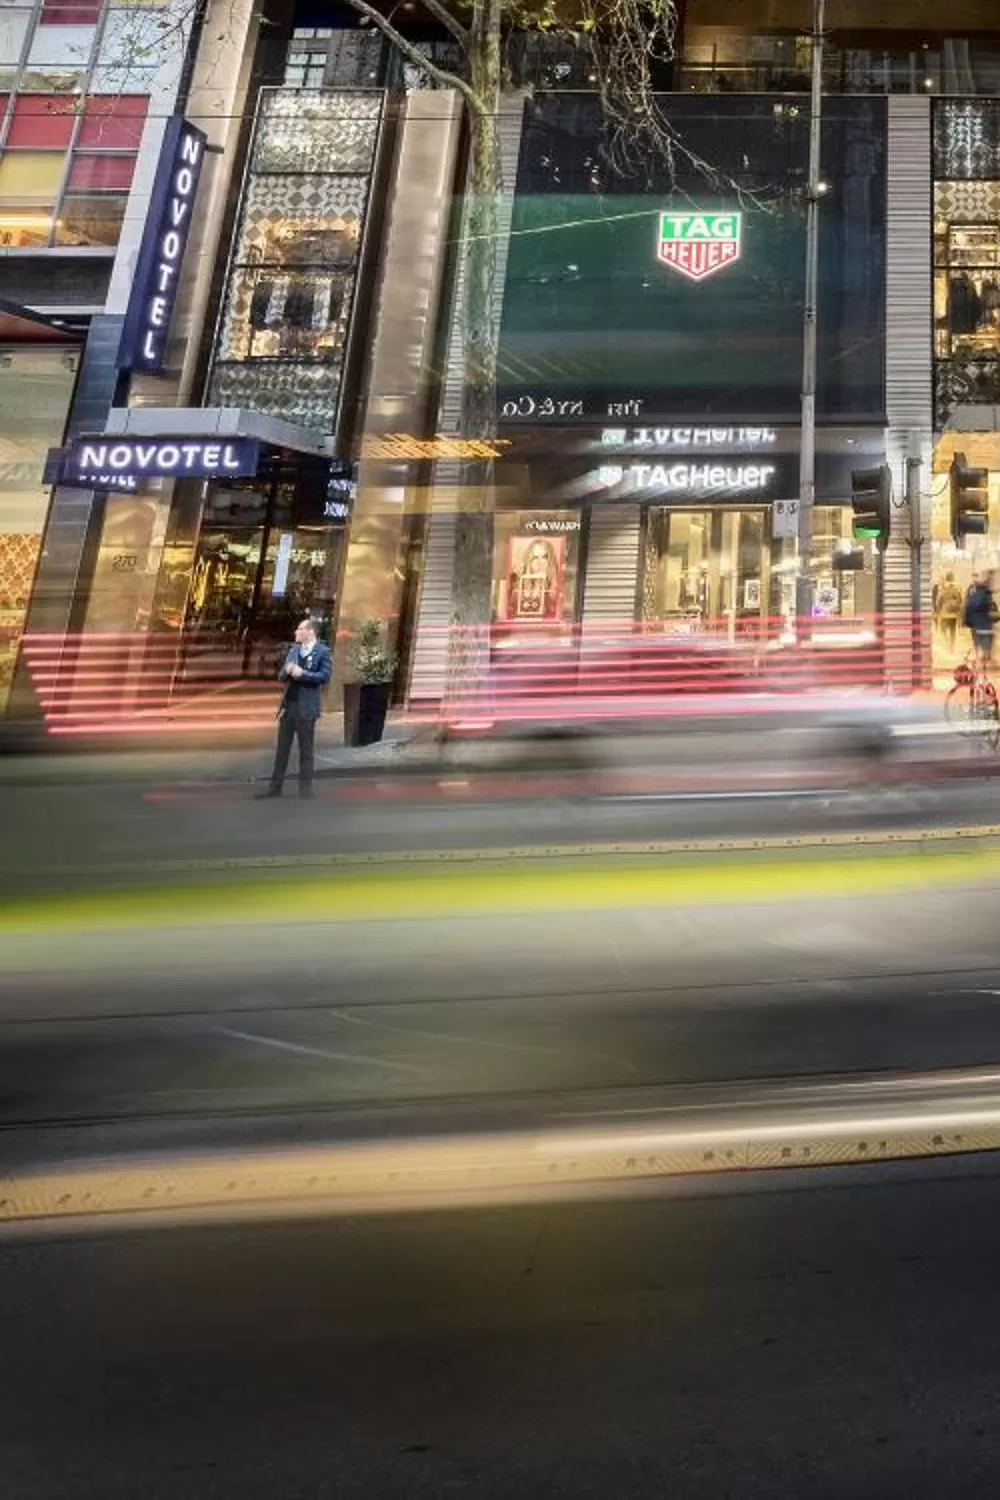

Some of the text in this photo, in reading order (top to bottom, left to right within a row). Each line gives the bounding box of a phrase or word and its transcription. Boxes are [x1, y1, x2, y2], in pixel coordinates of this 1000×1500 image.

[666, 217, 733, 238] TAG
[143, 135, 200, 360] NOVOTEL
[662, 242, 735, 274] HEUER
[80, 444, 240, 469] NOVOTEL
[630, 464, 776, 487] TAGHeuer
